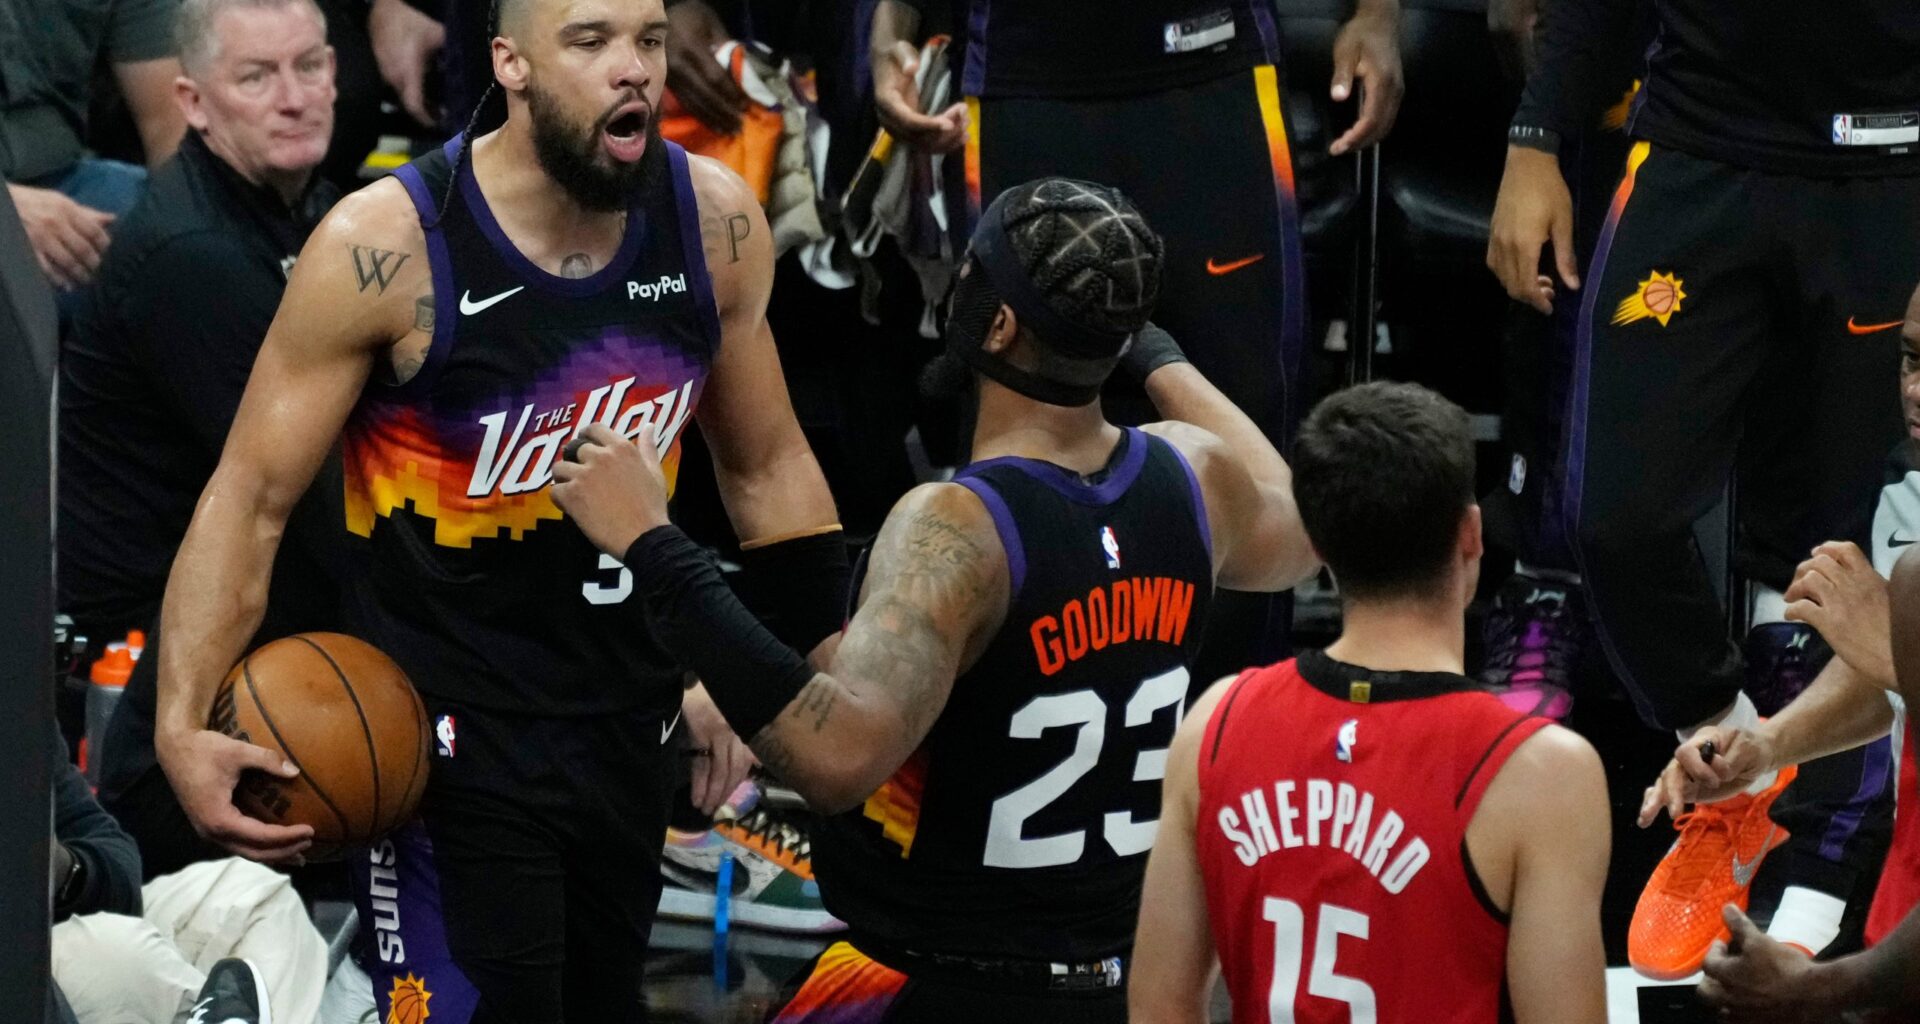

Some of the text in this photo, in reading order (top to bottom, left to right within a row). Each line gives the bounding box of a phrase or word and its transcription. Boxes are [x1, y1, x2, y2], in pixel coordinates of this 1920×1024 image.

[345, 243, 411, 296] W
[720, 211, 750, 265] P
[626, 273, 687, 301] PayPal
[535, 403, 577, 432] THE
[1030, 577, 1195, 676] GOODWIN
[983, 665, 1190, 868] 23
[1217, 778, 1431, 893] SHEPPARD
[1262, 896, 1377, 1024] 15
